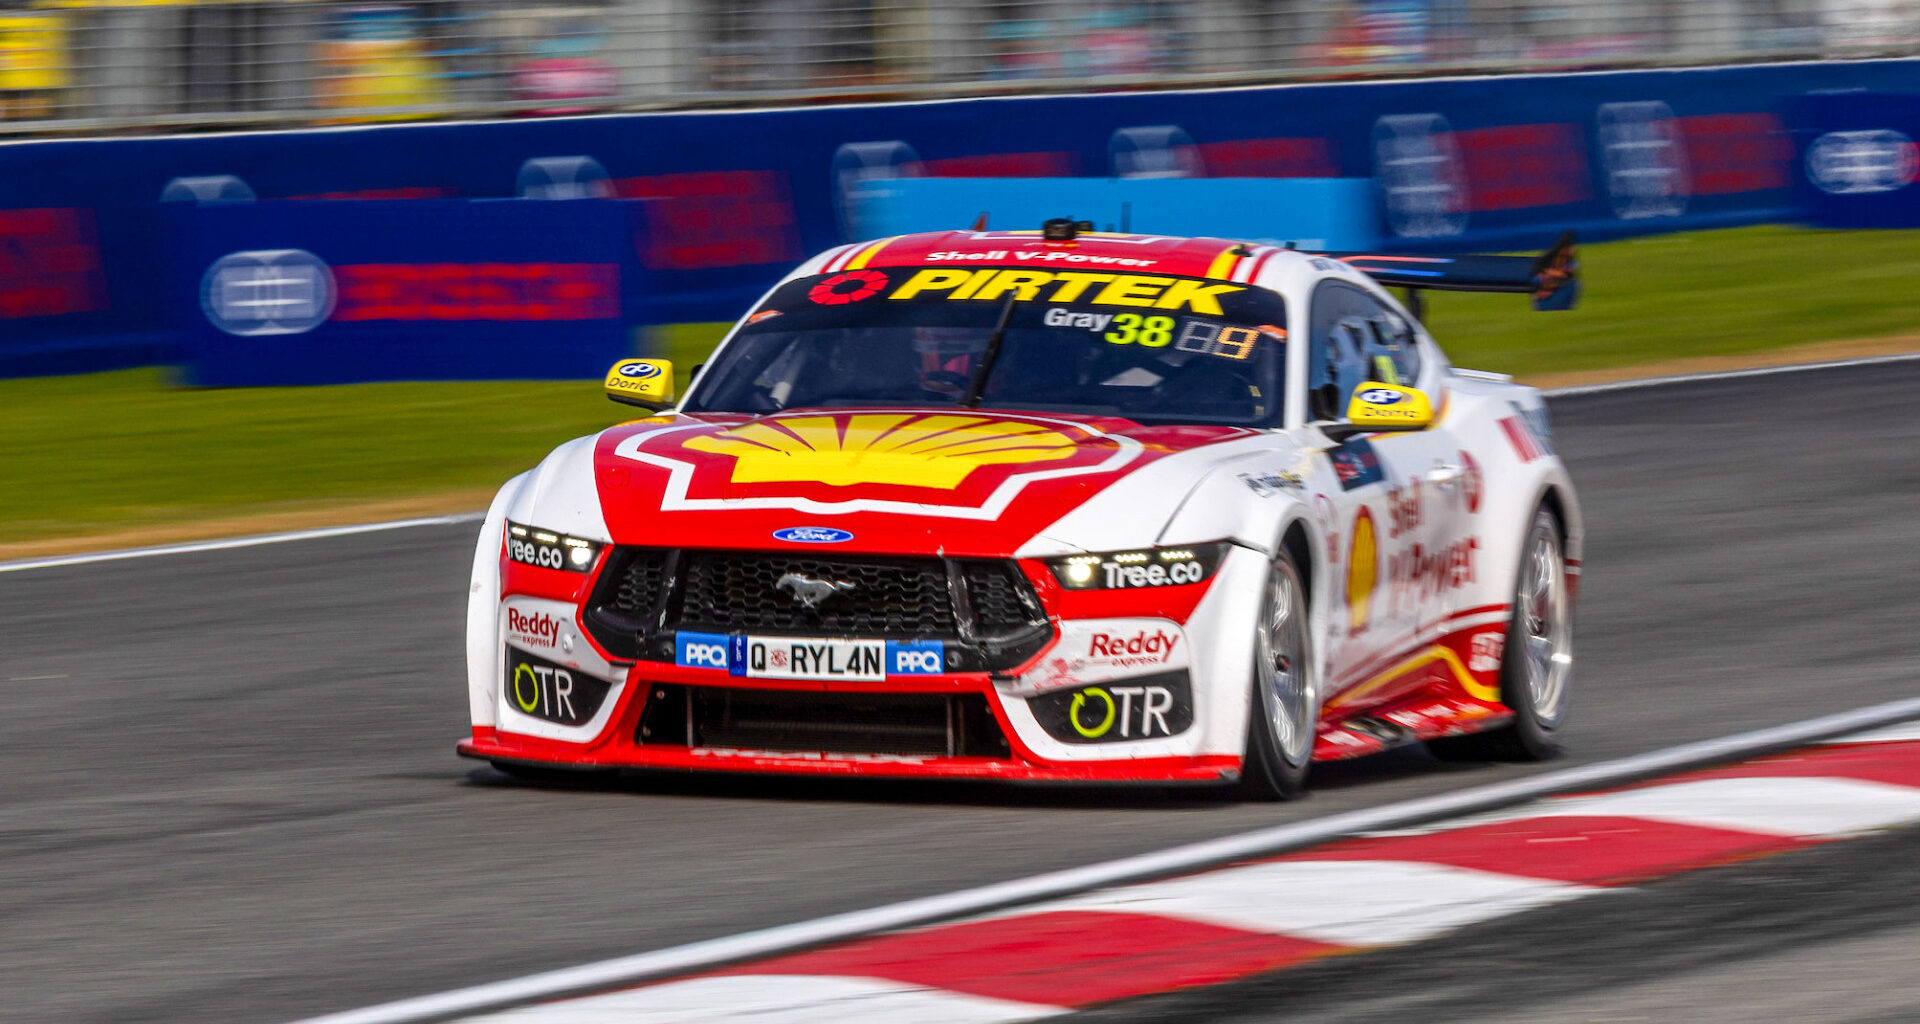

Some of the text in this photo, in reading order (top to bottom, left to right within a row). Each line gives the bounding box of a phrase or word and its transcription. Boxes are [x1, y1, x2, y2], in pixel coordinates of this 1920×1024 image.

[925, 250, 1157, 267] Shell V-Power
[888, 269, 1247, 316] PIRTEK
[1043, 307, 1176, 348] Gray 38
[608, 377, 650, 391] Doric
[786, 528, 839, 541] Ford
[1102, 560, 1203, 589] Tree.co
[508, 607, 560, 648] Reddy
[522, 635, 550, 649] express
[685, 642, 728, 667] PPQ
[750, 642, 766, 671] Q
[790, 643, 881, 676] RYL4N
[1088, 628, 1179, 663] Reddy
[896, 650, 942, 673] PPQ
[514, 662, 576, 720] OTR
[1069, 686, 1174, 739] OTR
